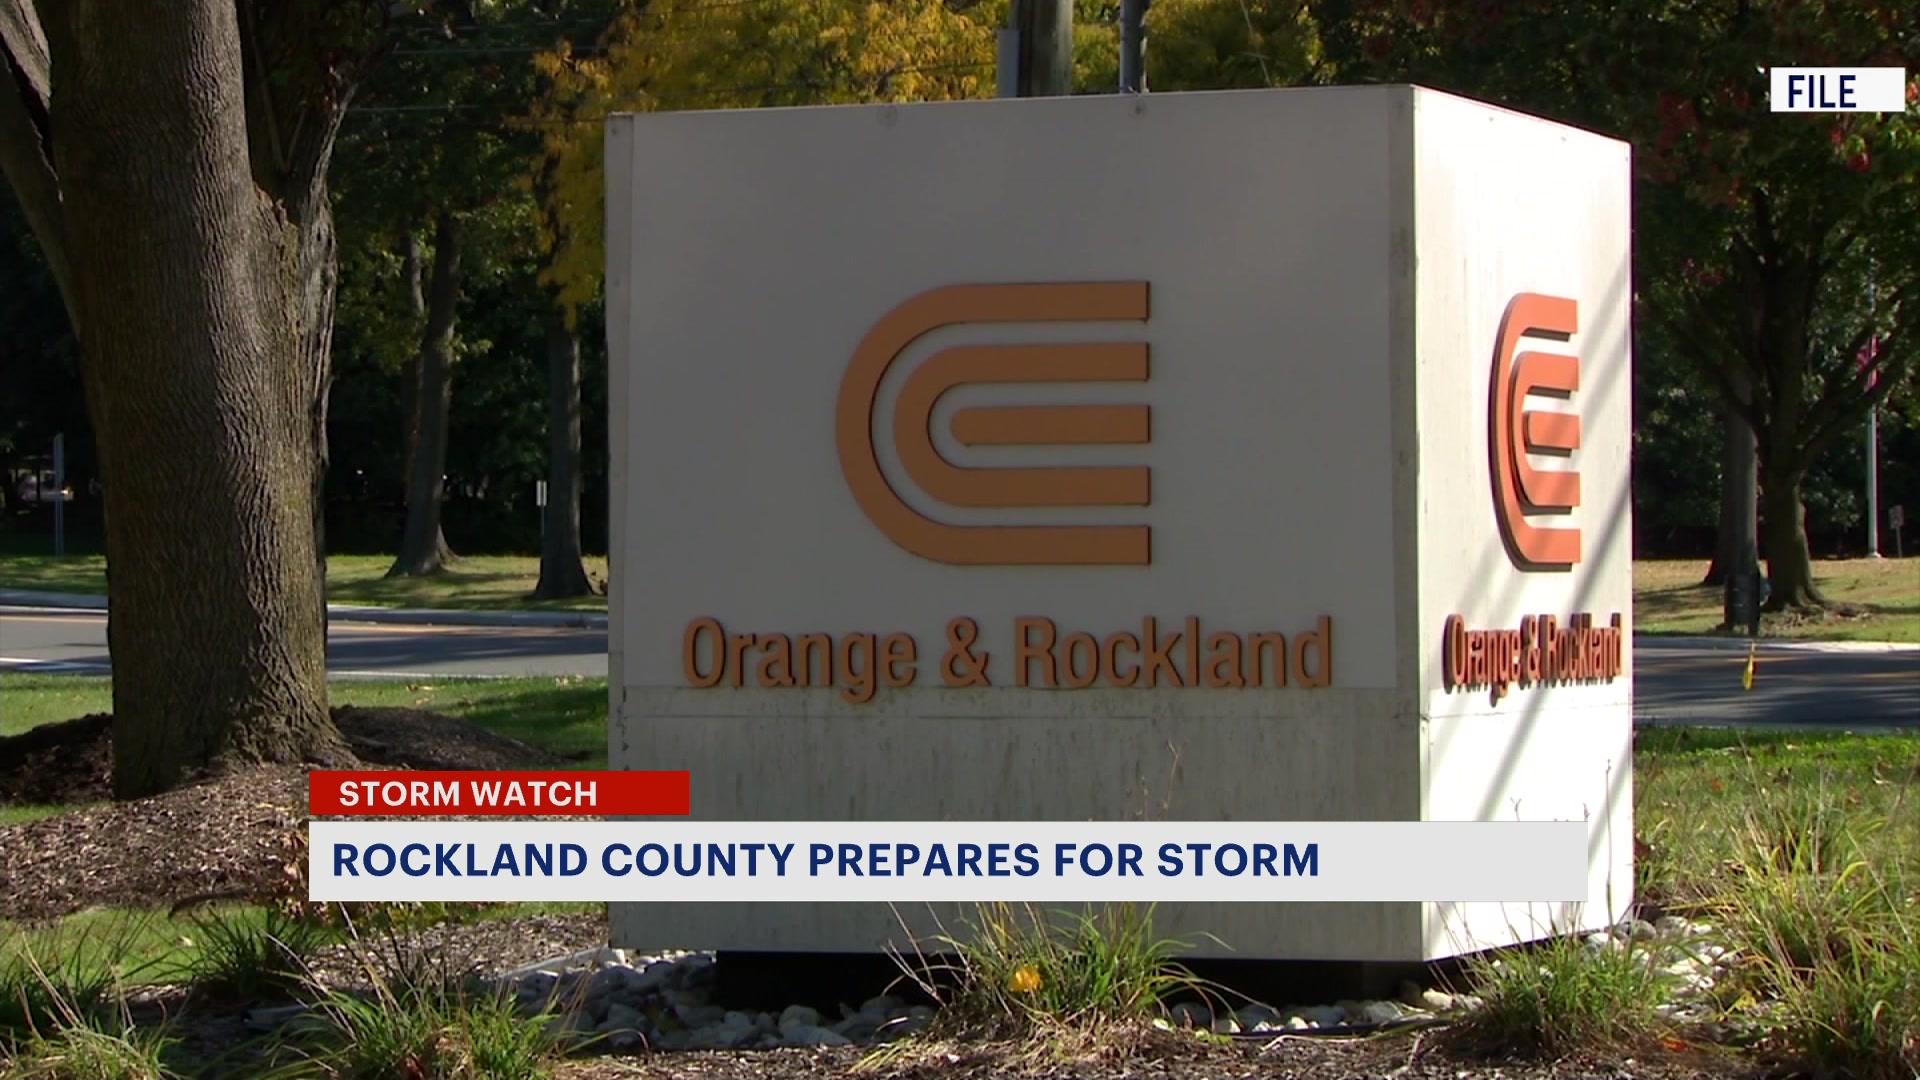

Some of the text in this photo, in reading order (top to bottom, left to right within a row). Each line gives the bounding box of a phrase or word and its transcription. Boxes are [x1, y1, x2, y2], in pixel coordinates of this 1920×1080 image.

[683, 615, 1333, 703] Orange & Rockland
[1444, 612, 1623, 704] Orange & Rockland
